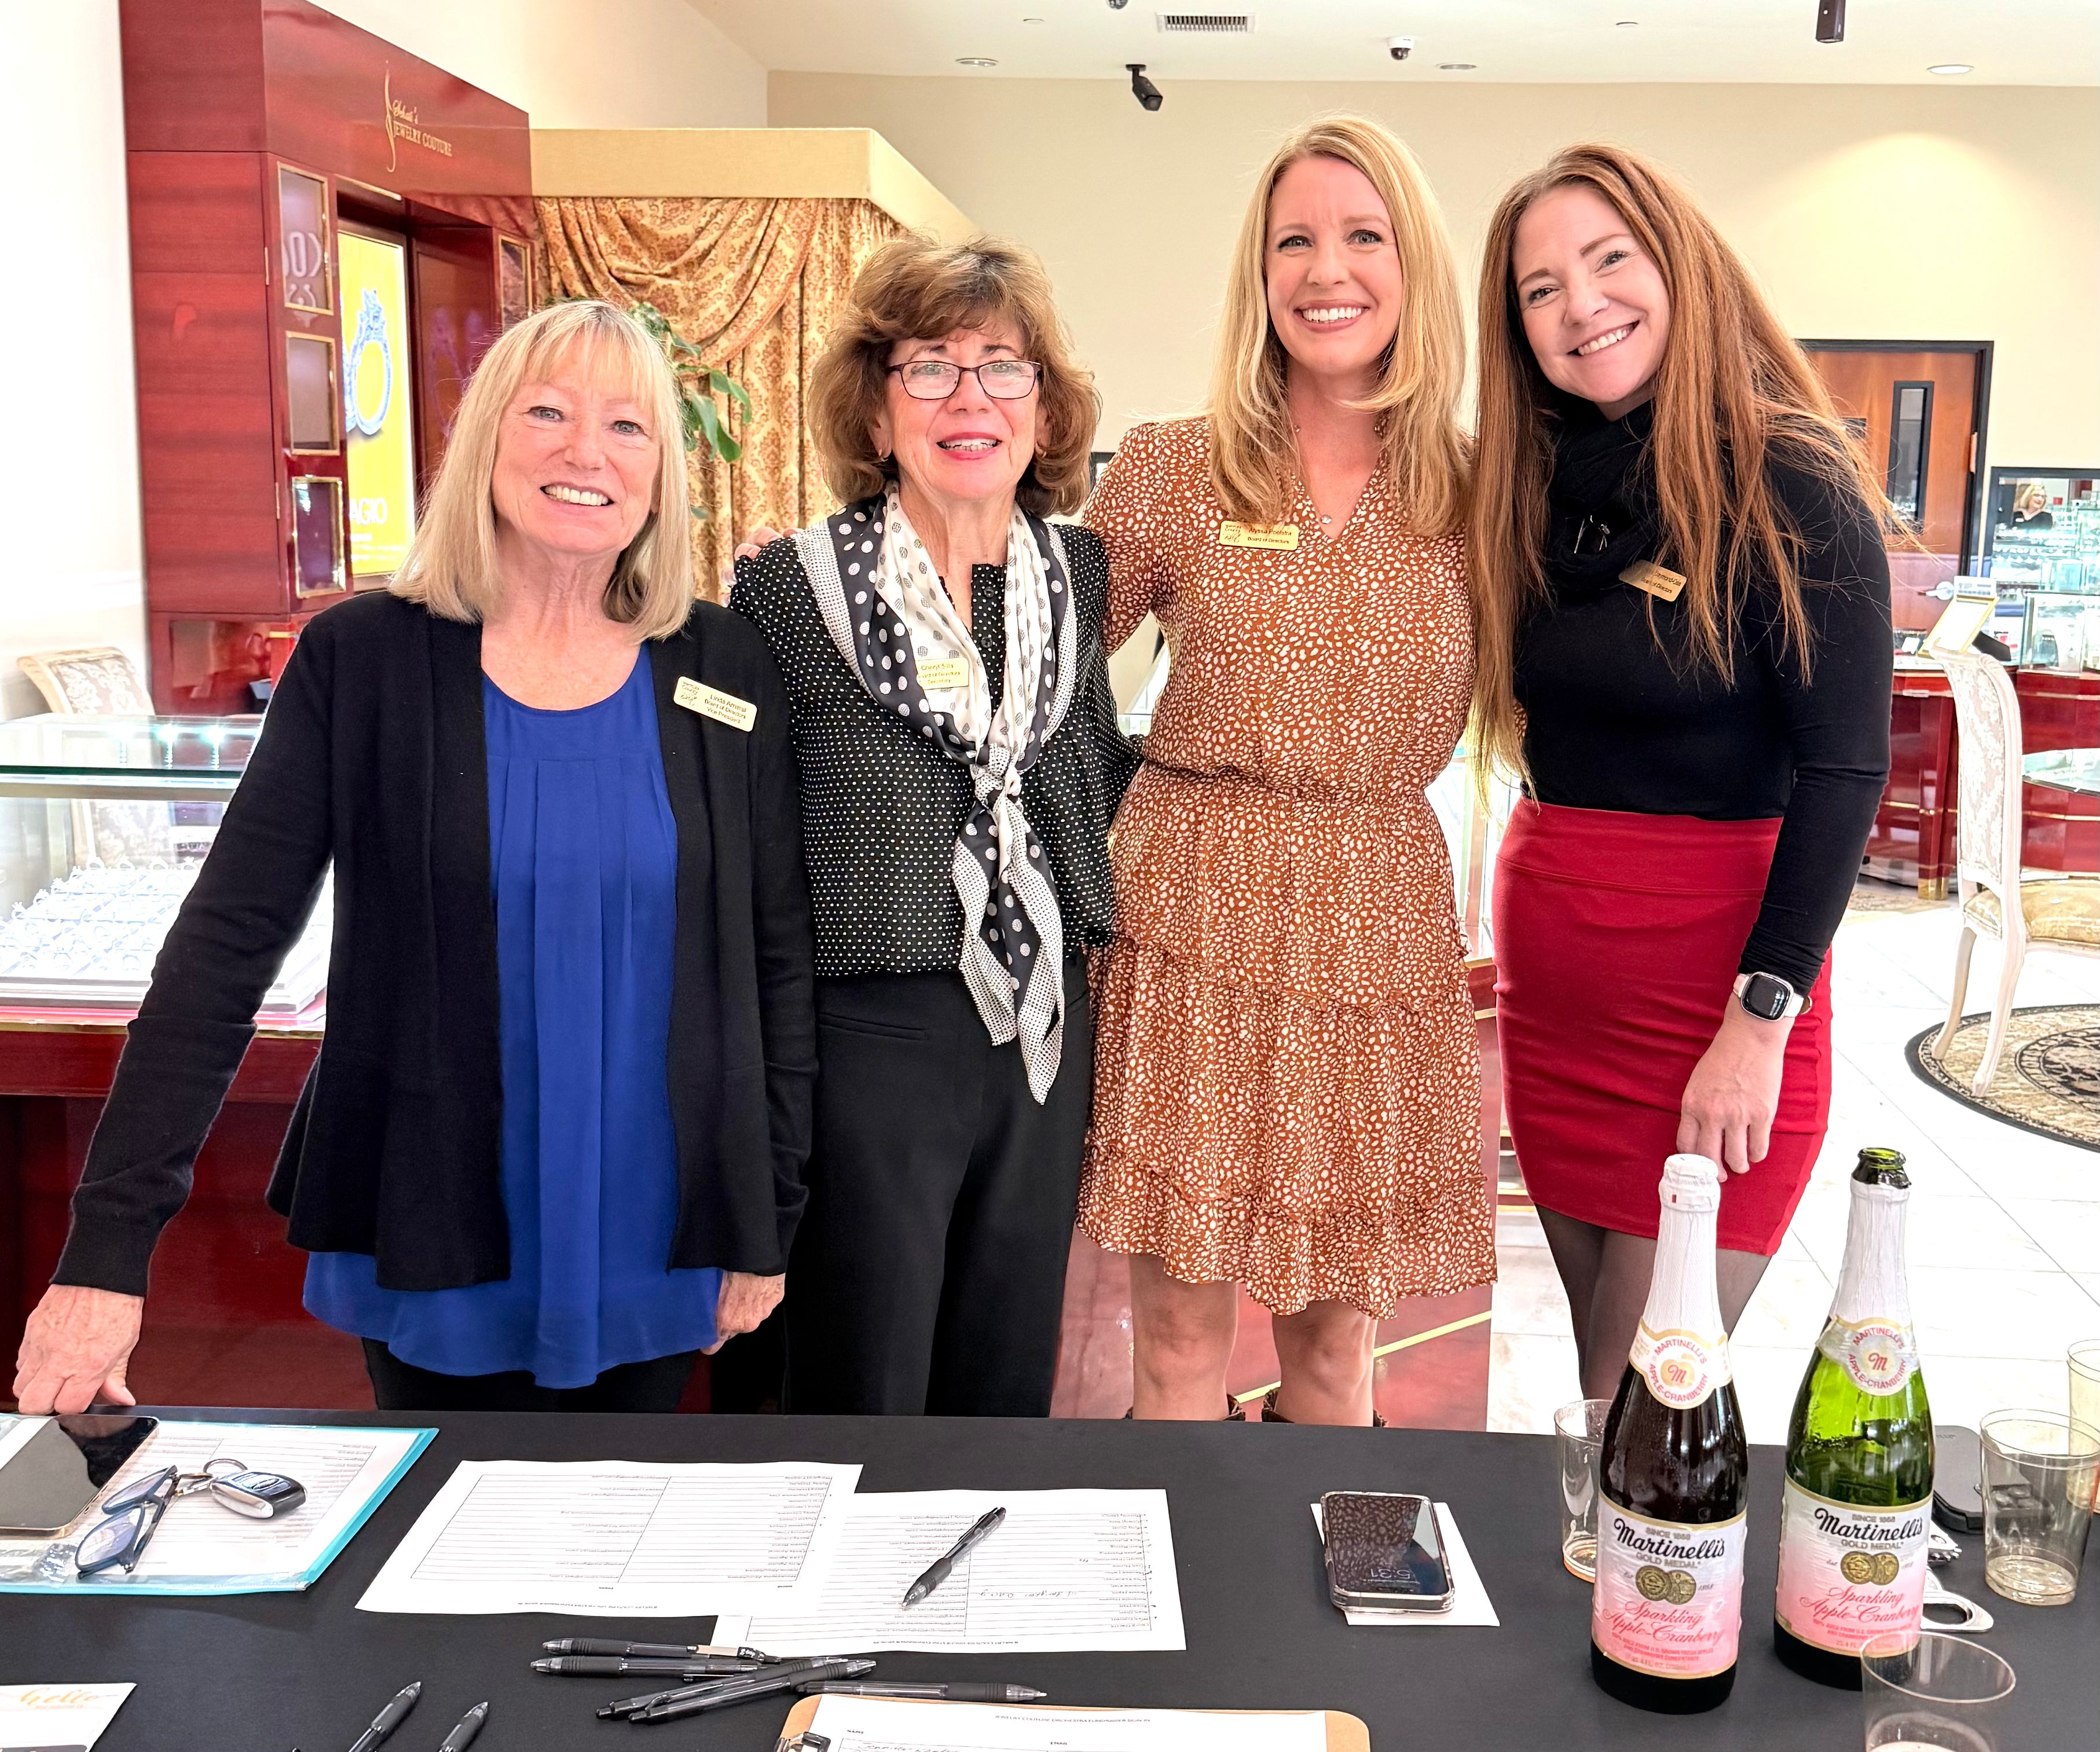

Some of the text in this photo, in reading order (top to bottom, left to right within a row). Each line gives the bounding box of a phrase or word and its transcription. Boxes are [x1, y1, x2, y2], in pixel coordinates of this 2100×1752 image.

[704, 699, 719, 708] Board
[725, 707, 746, 719] Directors
[1654, 1339, 1707, 1364] MARTINELLI'S
[1848, 1354, 1906, 1389] APPLE-CRANBERRY
[1649, 1364, 1709, 1402] APPLE-CRANBERRY
[1852, 1513, 1877, 1523] SINCE
[1645, 1527, 1670, 1538] SINCE
[1841, 1538, 1868, 1549] GOLD
[1636, 1552, 1662, 1565] GOLD
[1370, 1568, 1411, 1579] 5:31
[1826, 1585, 1904, 1608] Sparkling
[1625, 1601, 1705, 1630] Sparkling
[1800, 1597, 1919, 1623] Apple-Cranberry
[1602, 1608, 1724, 1646] Apple-Cranberry
[20, 1687, 103, 1706] hello
